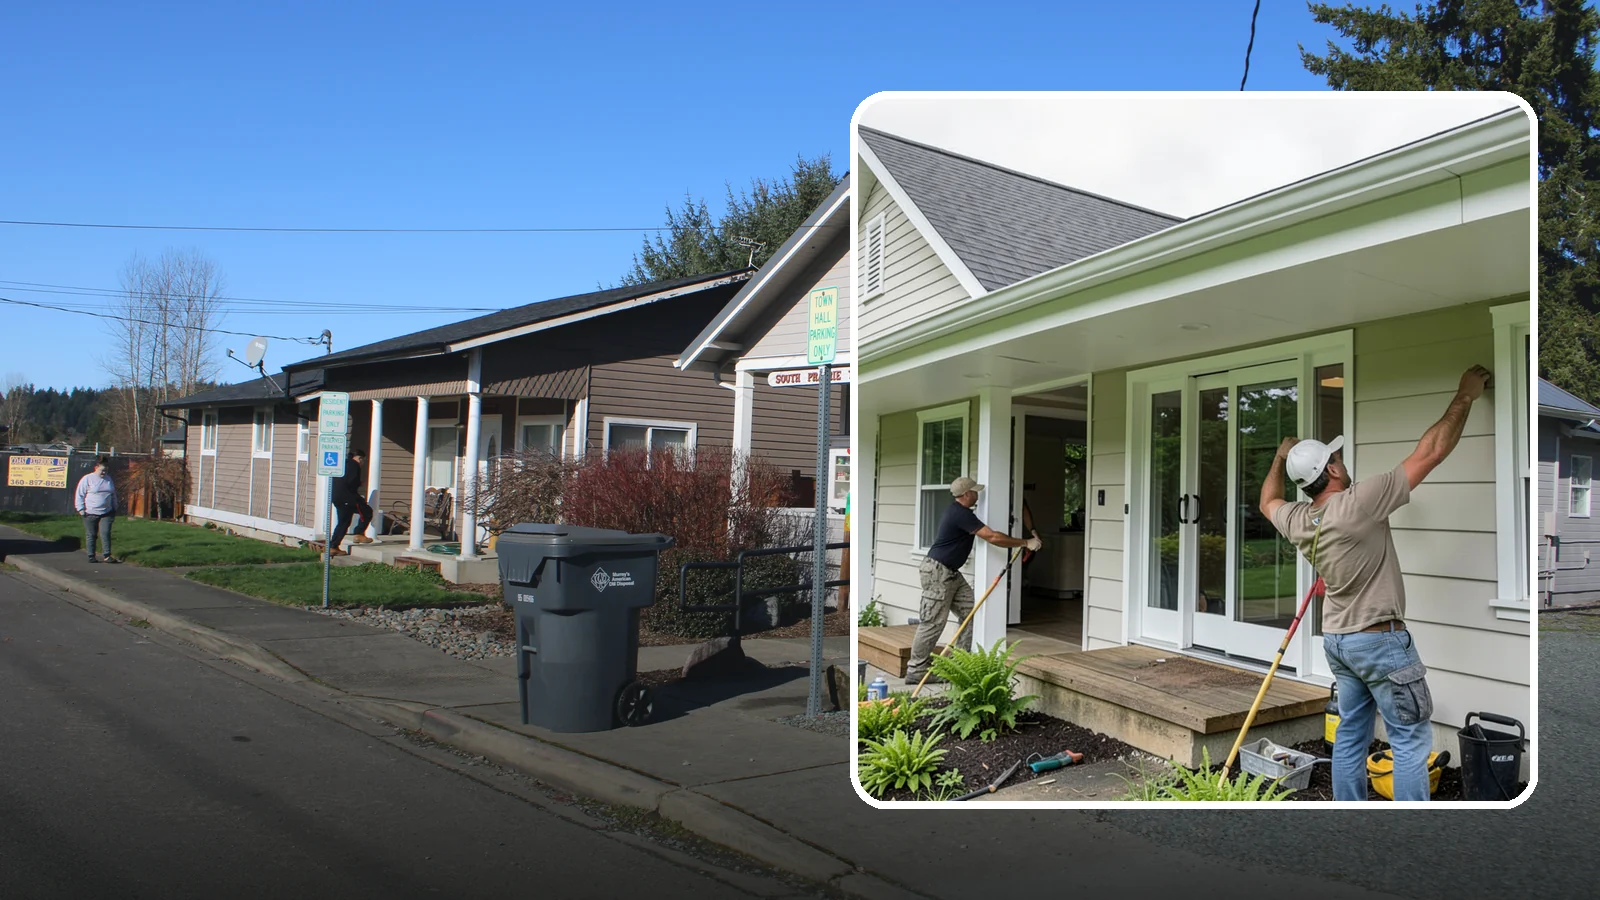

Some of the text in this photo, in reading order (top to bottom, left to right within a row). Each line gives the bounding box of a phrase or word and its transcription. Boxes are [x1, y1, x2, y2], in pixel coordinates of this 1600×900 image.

[815, 294, 832, 308] TOWN
[814, 312, 830, 324] HALL
[810, 326, 836, 340] PARKING
[814, 344, 830, 356] ONLY
[775, 374, 800, 384] SOUTH
